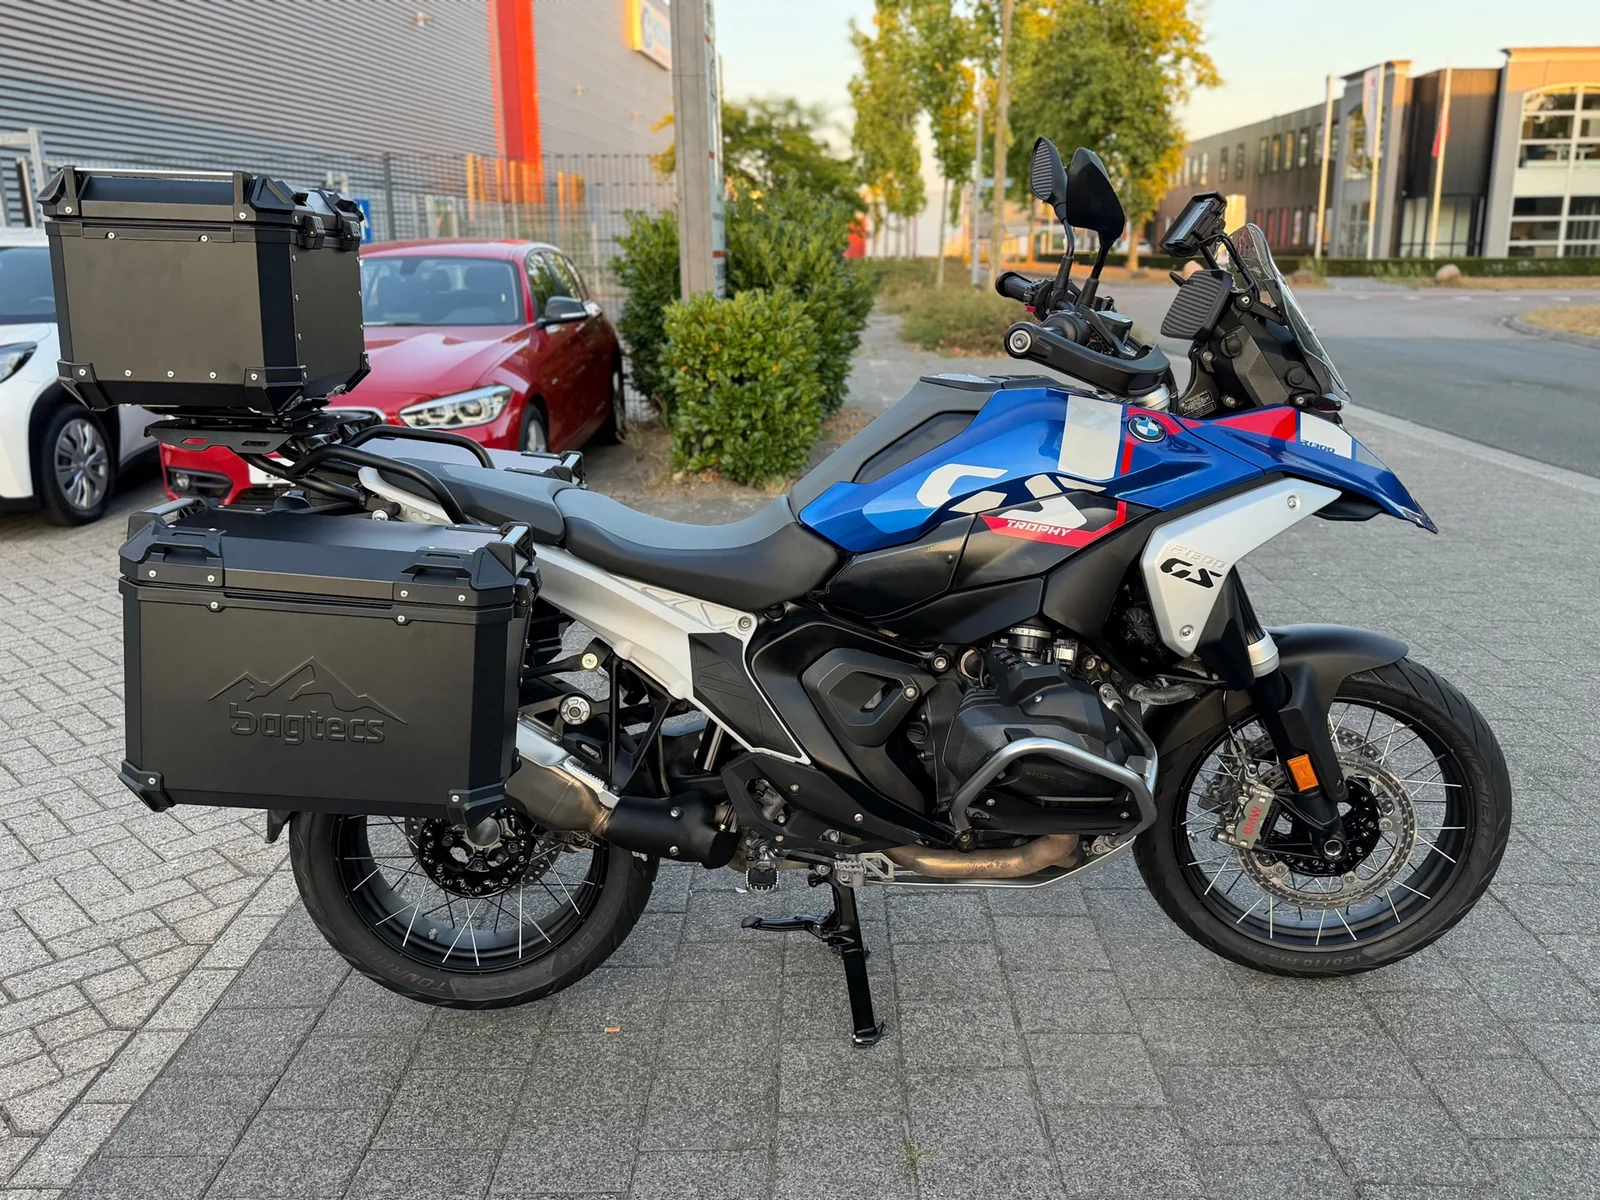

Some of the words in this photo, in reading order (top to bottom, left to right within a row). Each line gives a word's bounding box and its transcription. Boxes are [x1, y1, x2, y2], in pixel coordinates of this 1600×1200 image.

[1006, 519, 1071, 537] TROPHY
[1160, 557, 1223, 589] GS
[229, 702, 386, 745] bagtecs
[1242, 805, 1262, 836] BMW
